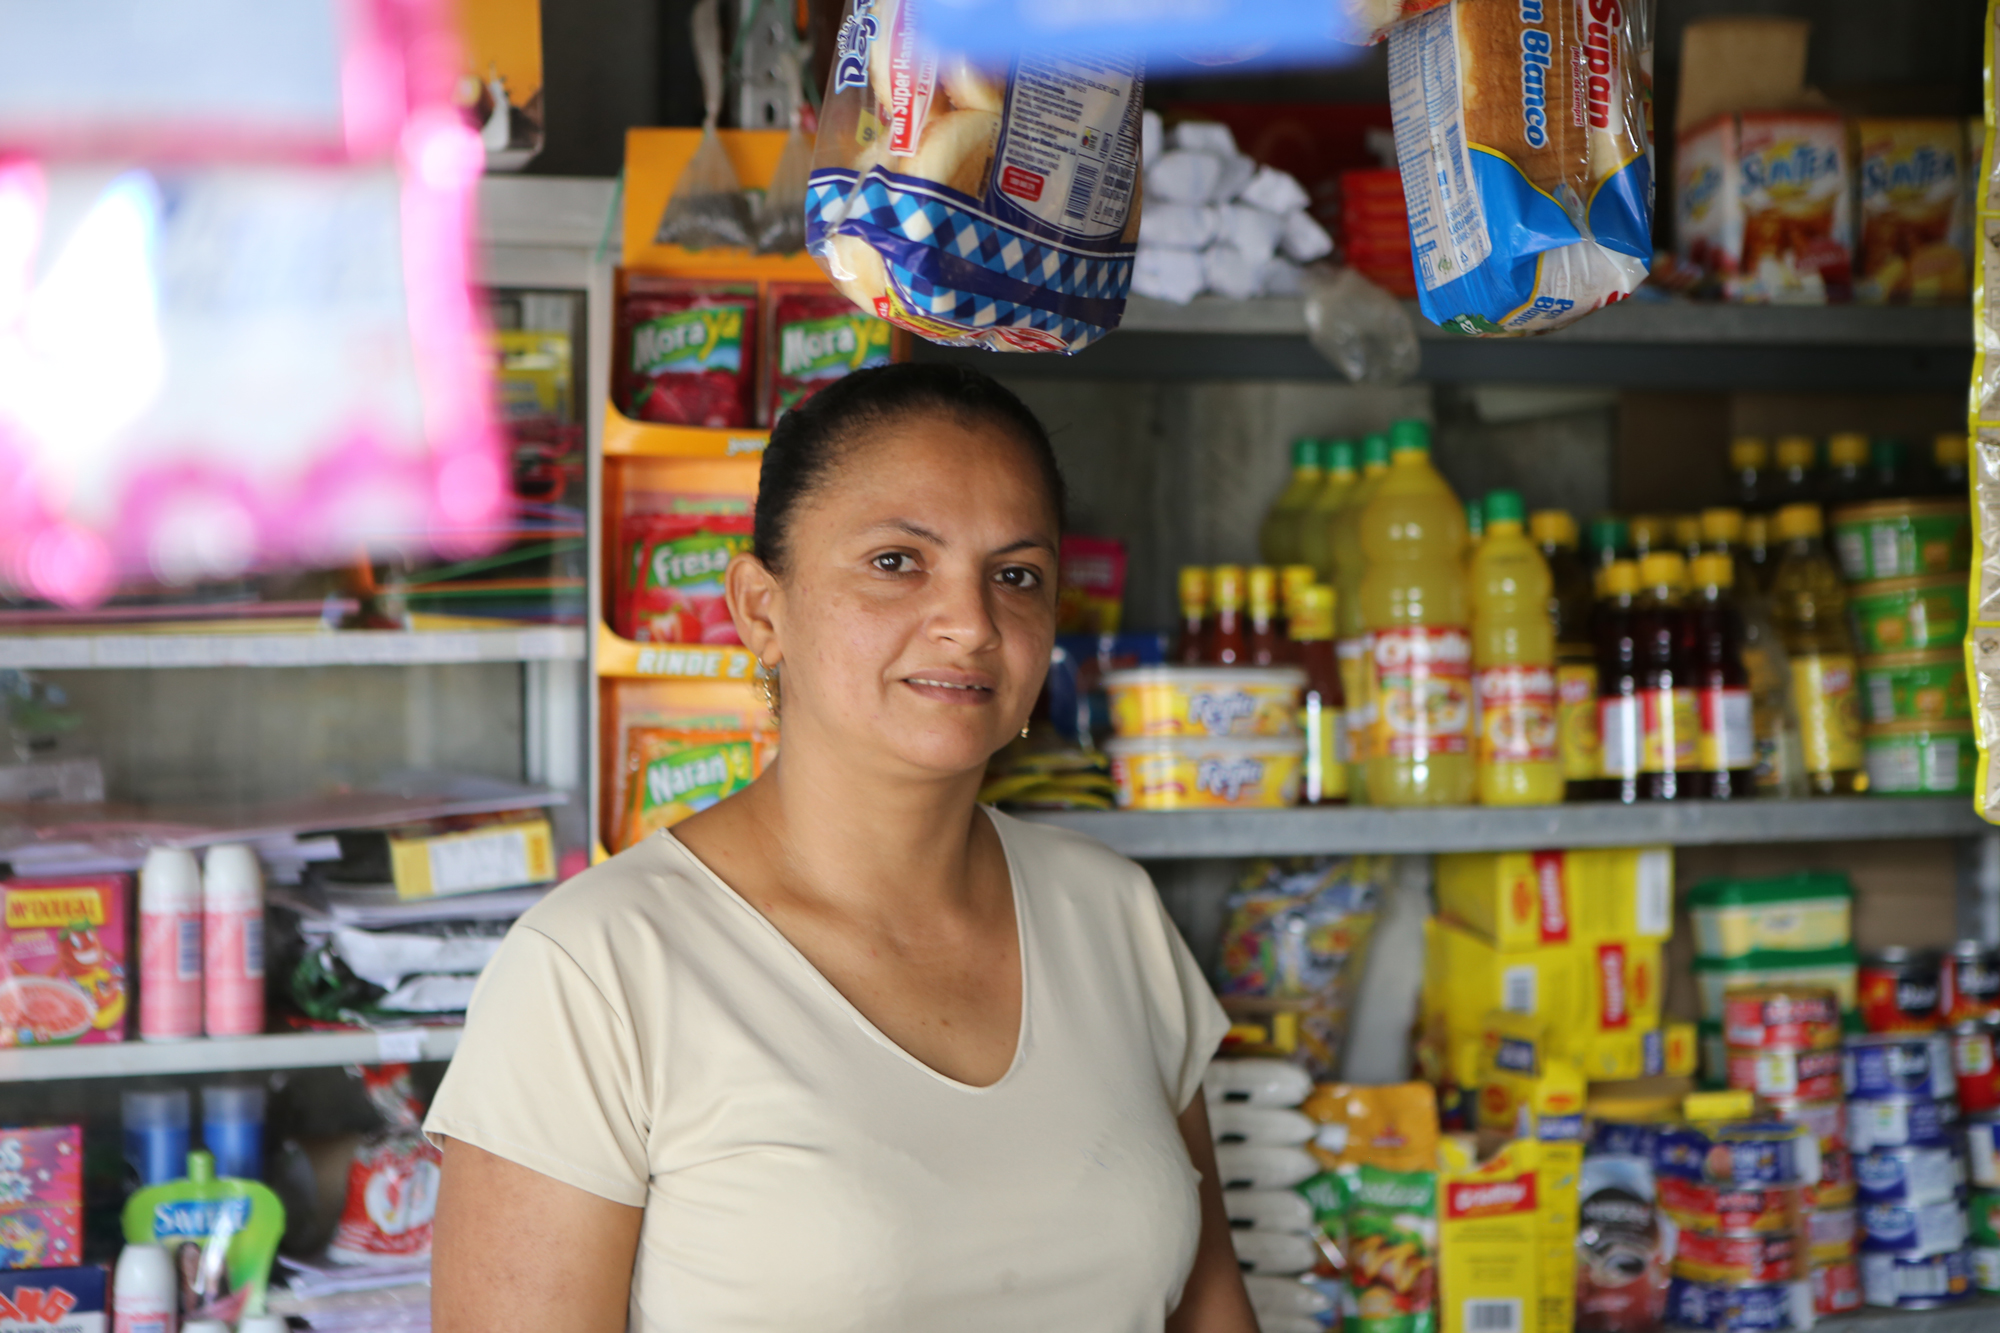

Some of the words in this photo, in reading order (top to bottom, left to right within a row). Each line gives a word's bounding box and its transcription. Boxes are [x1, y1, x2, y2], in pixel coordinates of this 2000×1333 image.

[837, 16, 878, 88] Rey
[1583, 0, 1621, 129] Supan
[892, 71, 912, 115] Super
[917, 82, 930, 98] 12
[1521, 29, 1550, 146] Blanco
[652, 546, 729, 588] Fresa
[636, 650, 723, 677] RINDE
[725, 654, 751, 679] 2
[650, 754, 728, 805] Naran
